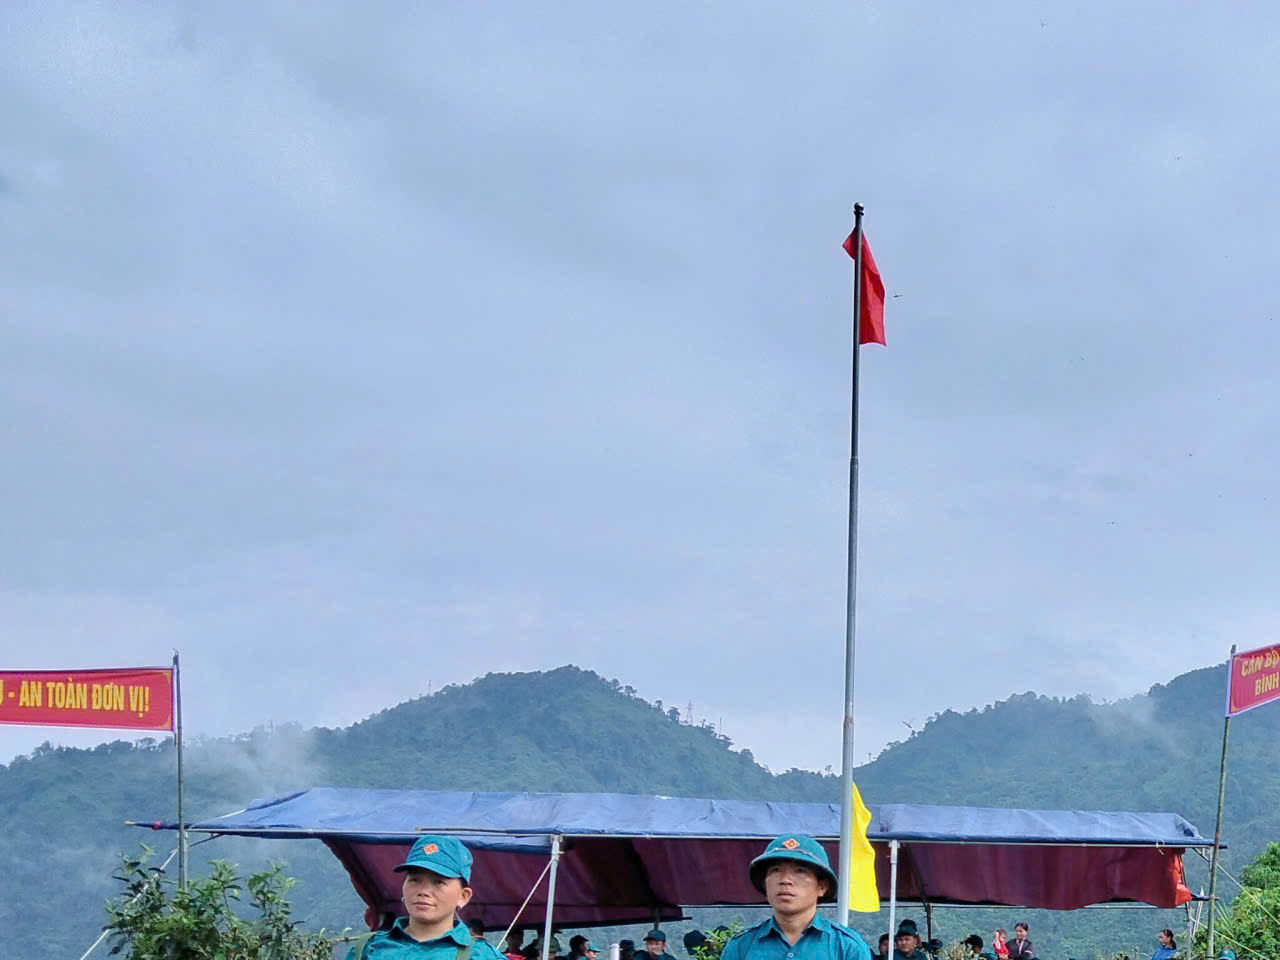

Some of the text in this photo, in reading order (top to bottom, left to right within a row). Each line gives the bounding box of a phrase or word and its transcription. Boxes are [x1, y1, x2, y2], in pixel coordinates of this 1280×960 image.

[19, 680, 42, 707] AN
[46, 677, 88, 709] TOÀN
[91, 682, 125, 711] ĐƠN
[128, 685, 150, 718] VỊ!
